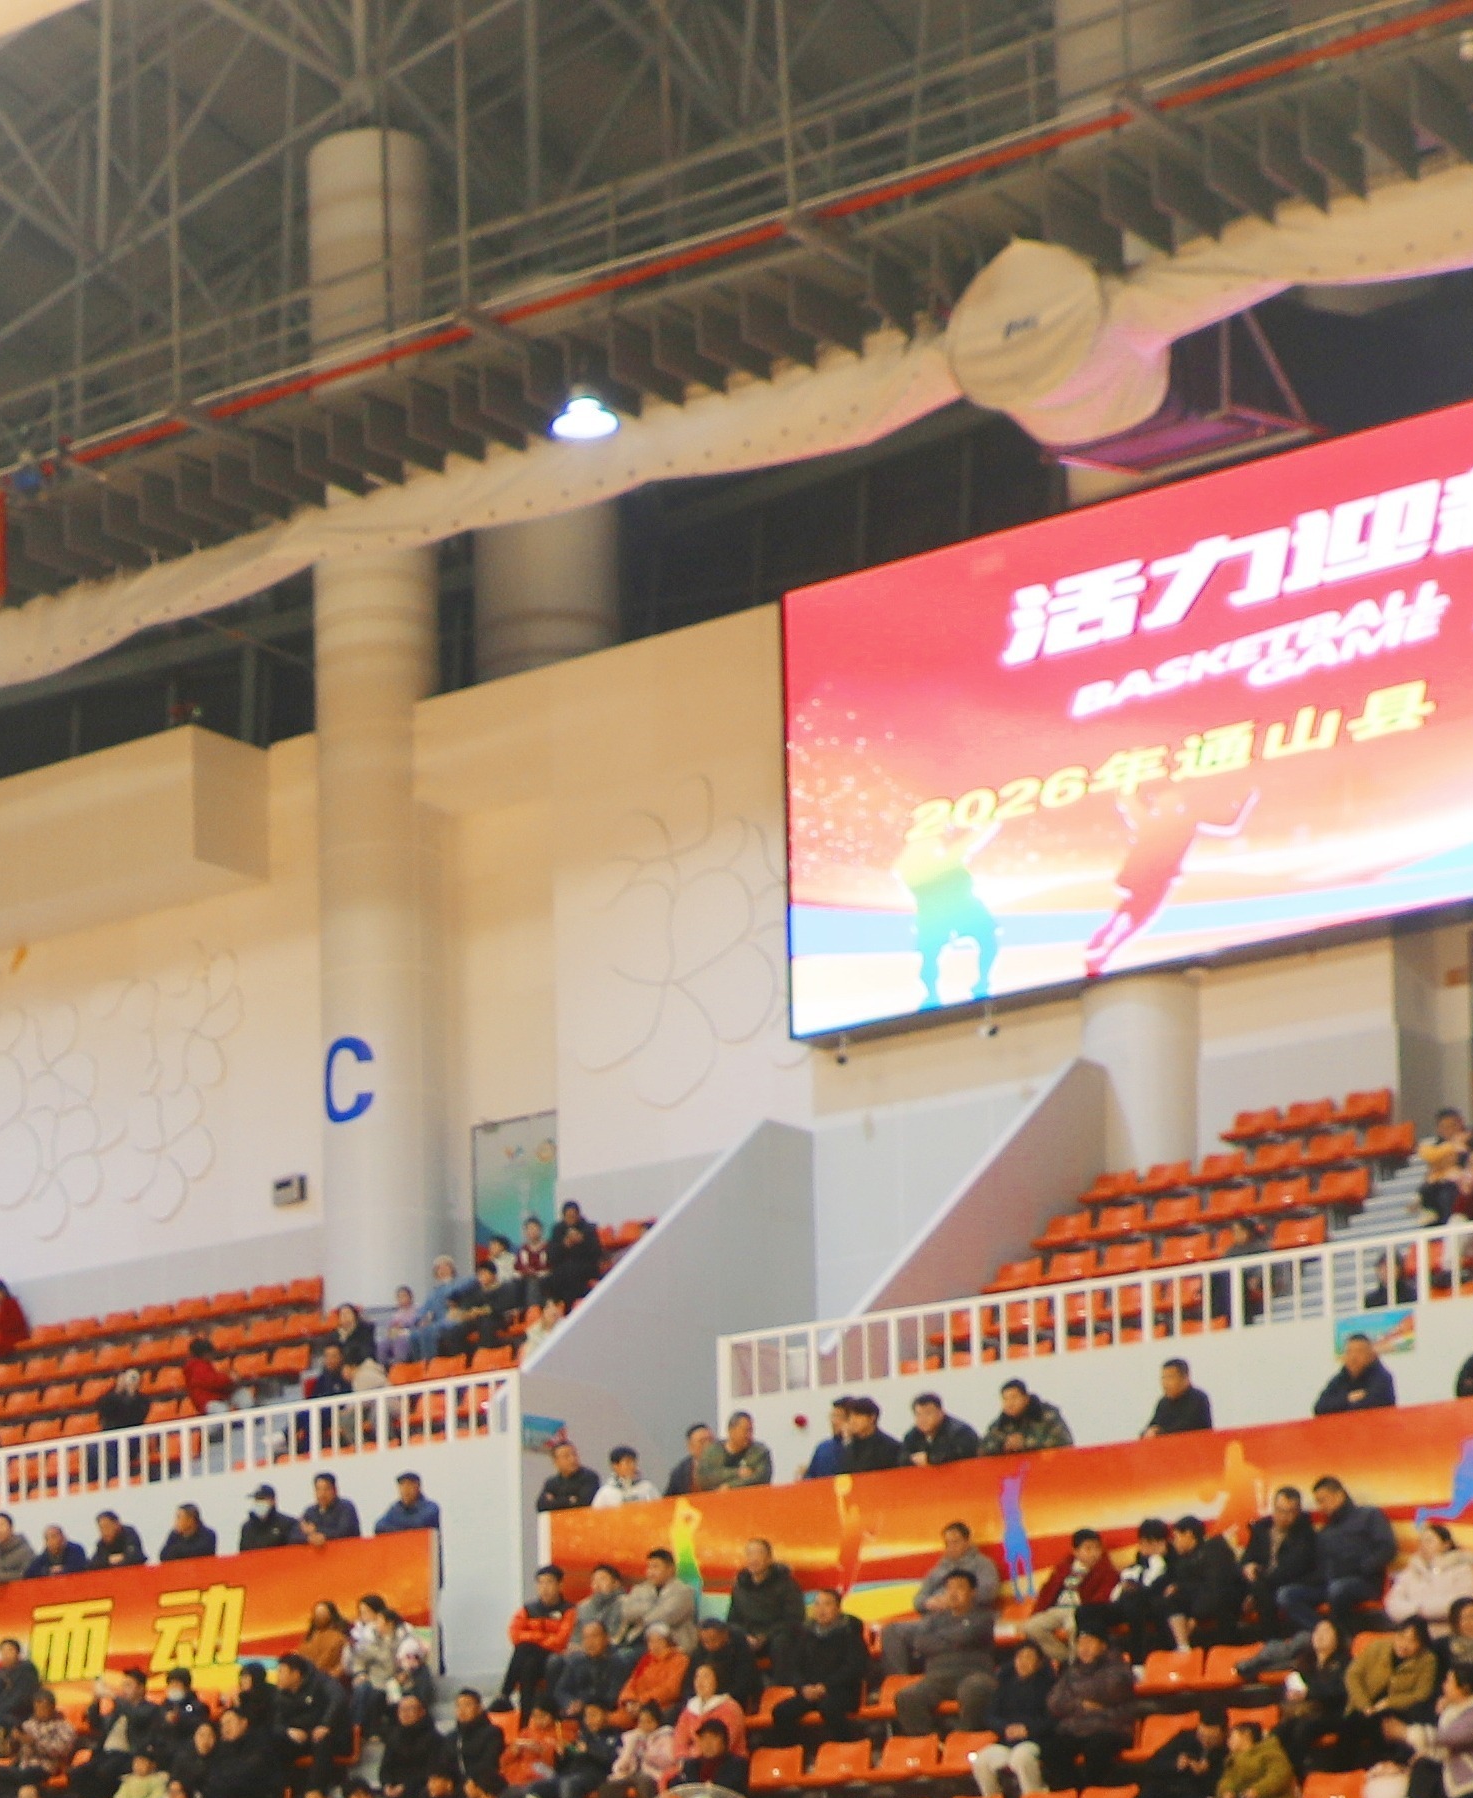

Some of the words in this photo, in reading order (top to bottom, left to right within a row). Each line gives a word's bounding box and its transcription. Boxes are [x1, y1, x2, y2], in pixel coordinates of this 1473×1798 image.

[1070, 580, 1449, 721] BASKETBALL
[1245, 611, 1443, 688] GAME
[903, 680, 1436, 844] 2026年通山县
[324, 1035, 374, 1123] C
